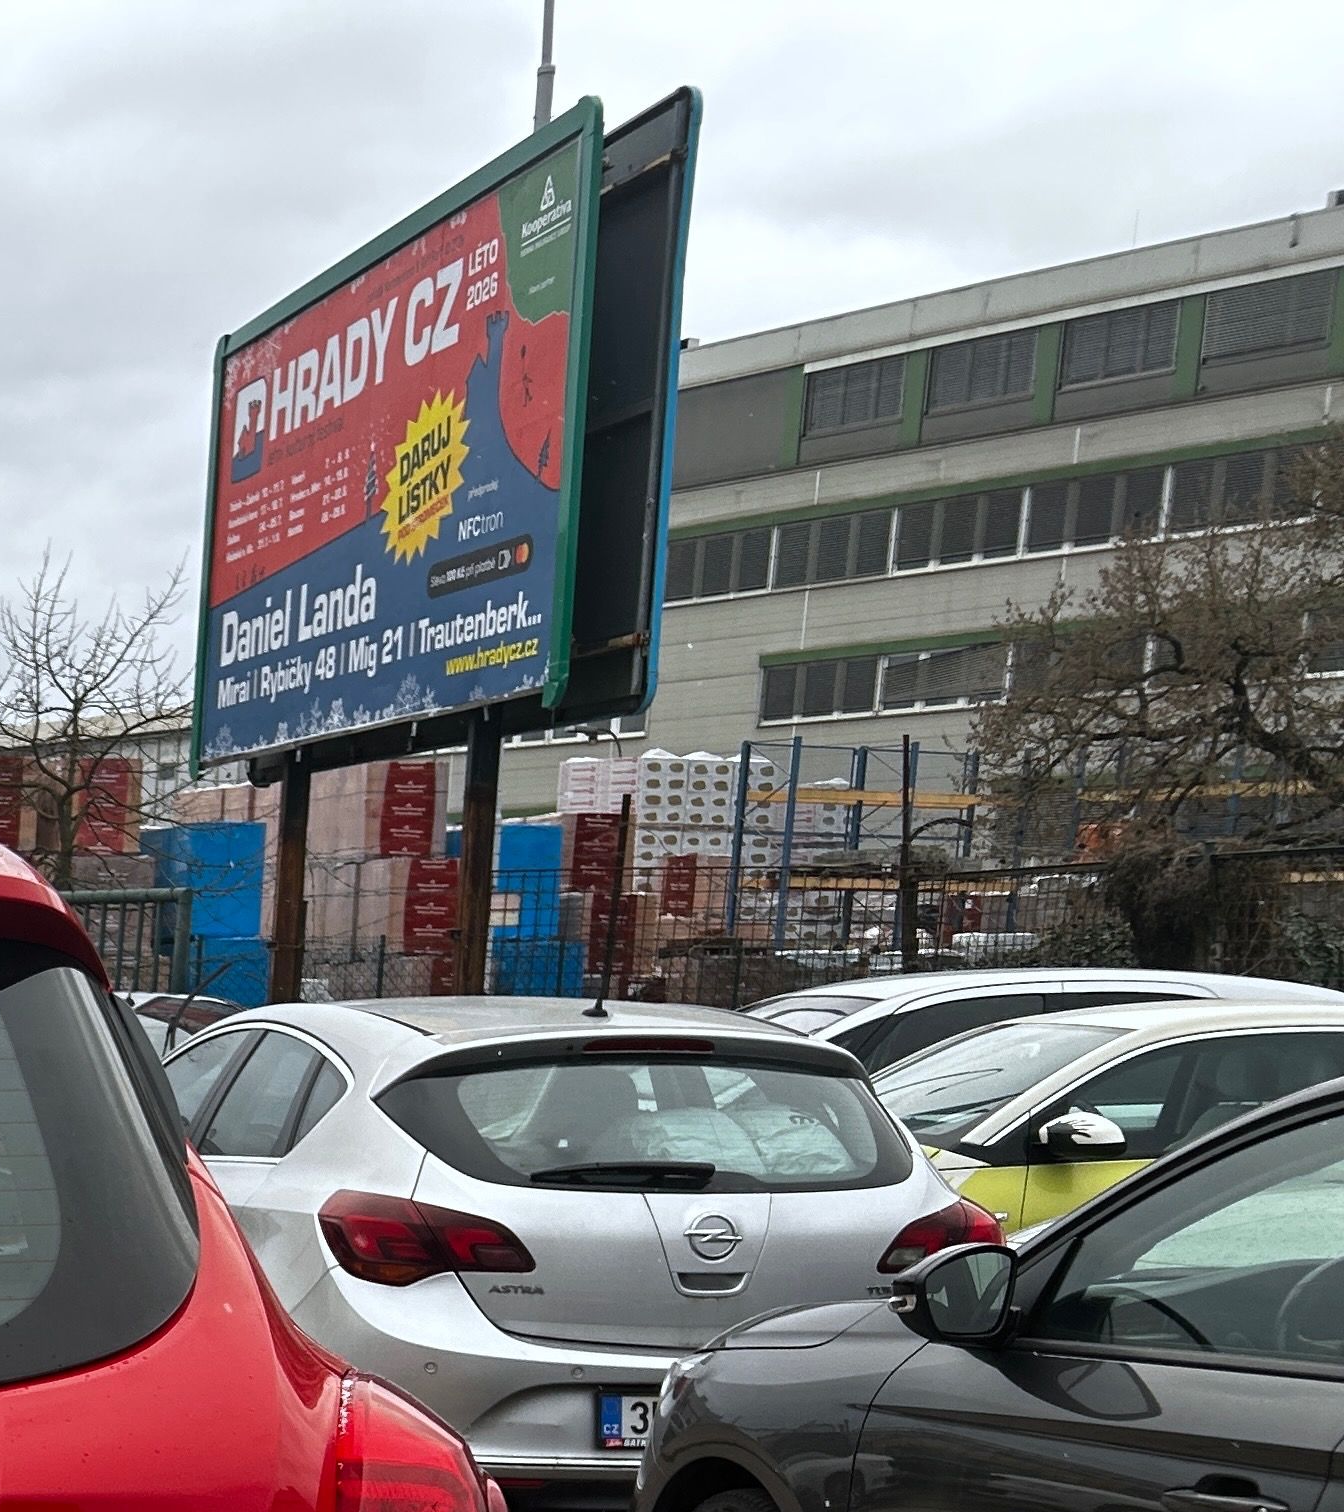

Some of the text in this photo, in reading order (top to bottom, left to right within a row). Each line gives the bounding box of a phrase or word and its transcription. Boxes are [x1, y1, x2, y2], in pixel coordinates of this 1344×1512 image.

[521, 200, 572, 239] Kooperativa
[468, 238, 499, 277] LÉTO
[466, 271, 499, 311] 2026
[269, 296, 399, 441] HRADY
[404, 257, 464, 367] CZ
[399, 415, 451, 486] DARUJ
[398, 454, 452, 525] LÍSTKY
[458, 511, 504, 542] NFCtron
[220, 564, 377, 668] Daniel Landa
[217, 670, 251, 710] Mirai
[259, 655, 312, 704] Rybičky
[314, 644, 336, 681] 48
[348, 635, 377, 678] Mig
[381, 625, 404, 665] 21
[445, 637, 540, 677] www.hradycz.cz
[488, 1284, 544, 1295] ASTRA
[603, 1423, 619, 1435] CZ
